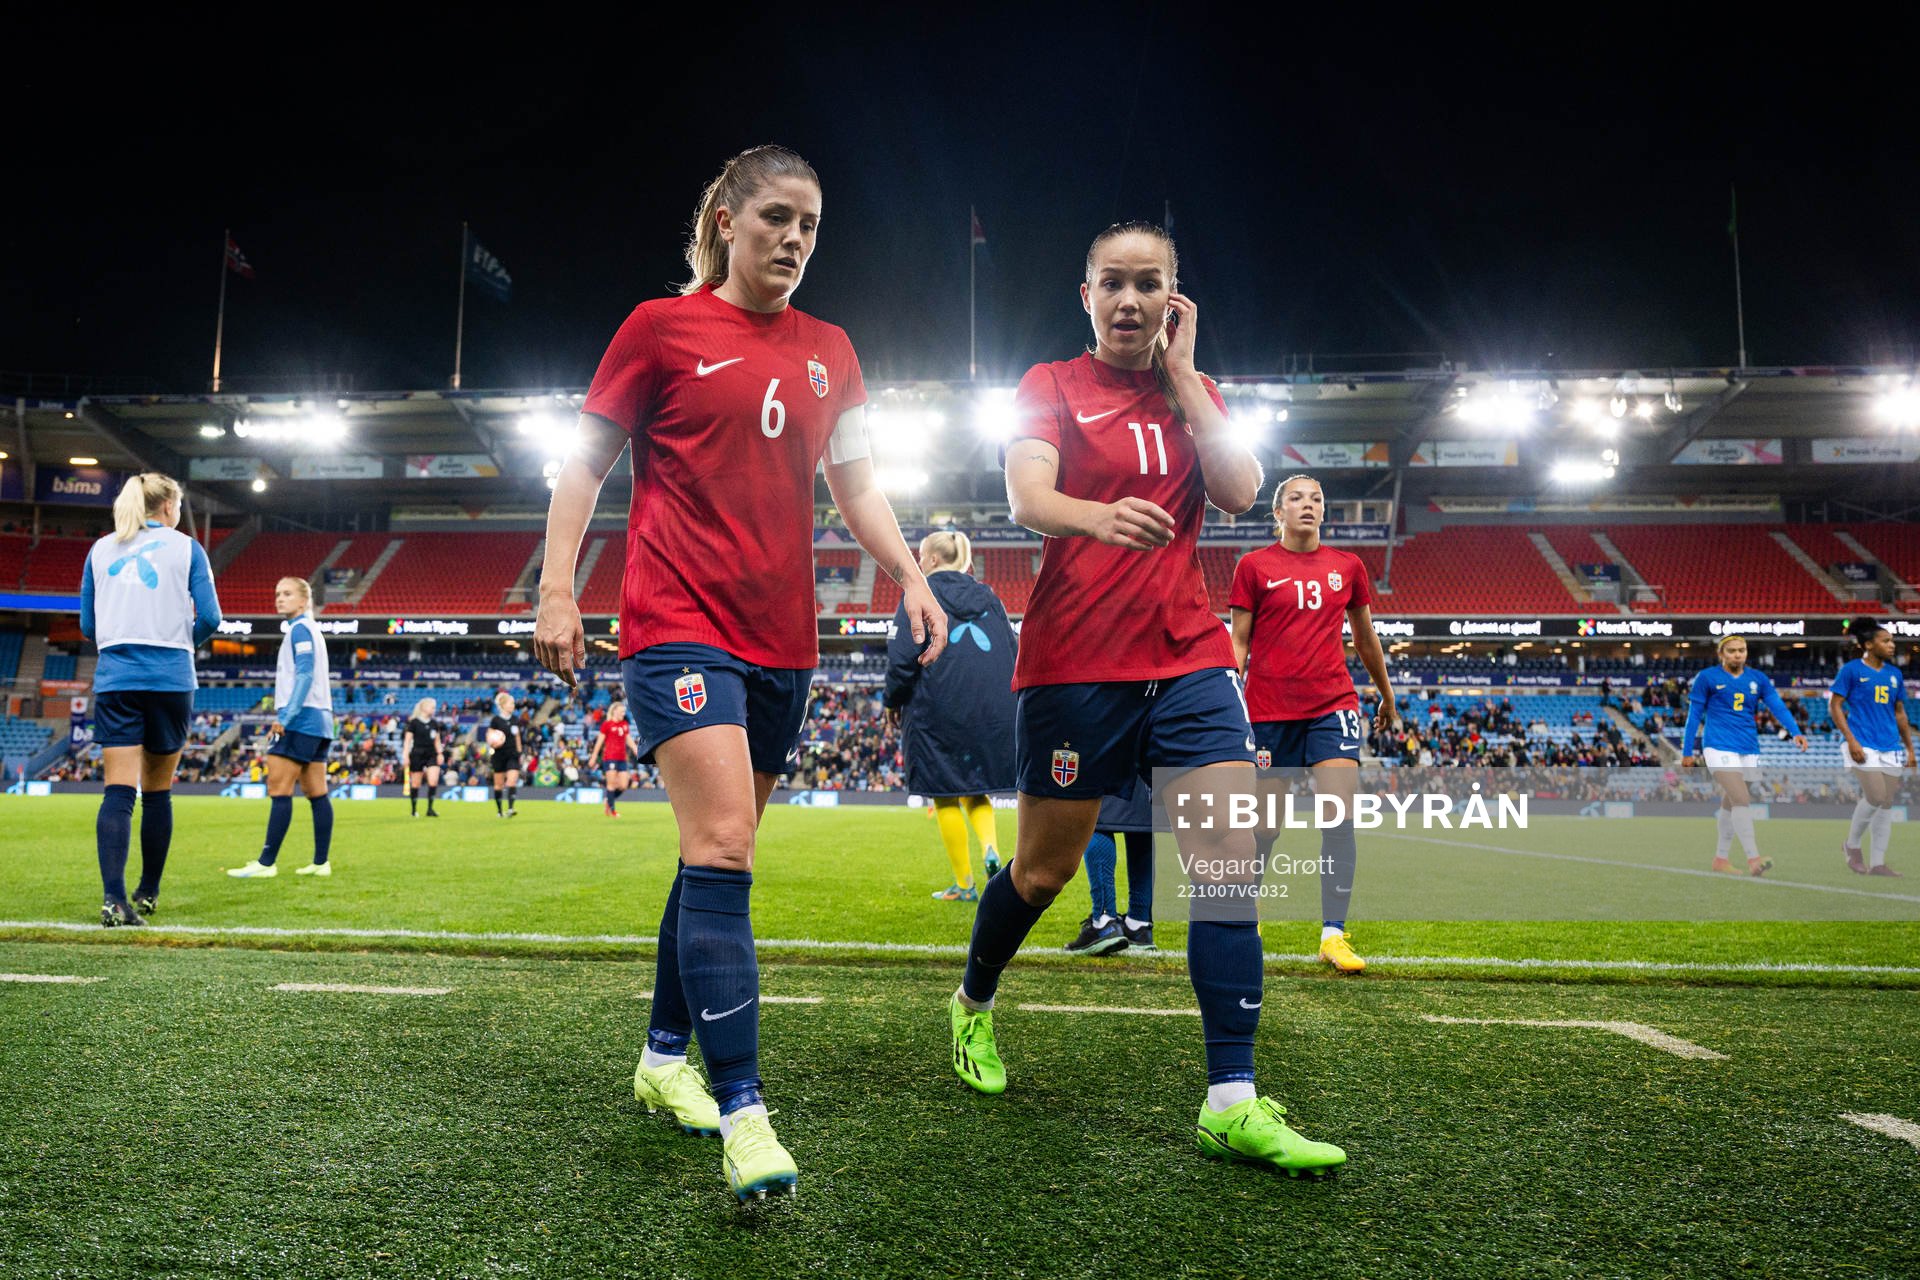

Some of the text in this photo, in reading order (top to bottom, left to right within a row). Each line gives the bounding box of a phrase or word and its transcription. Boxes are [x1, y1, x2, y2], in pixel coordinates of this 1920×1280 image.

[761, 378, 786, 439] 6
[1127, 422, 1168, 475] 11
[52, 476, 102, 495] bama
[1293, 580, 1323, 610] 13
[1733, 693, 1745, 711] 2
[1874, 686, 1890, 704] 15
[1335, 710, 1361, 739] 13
